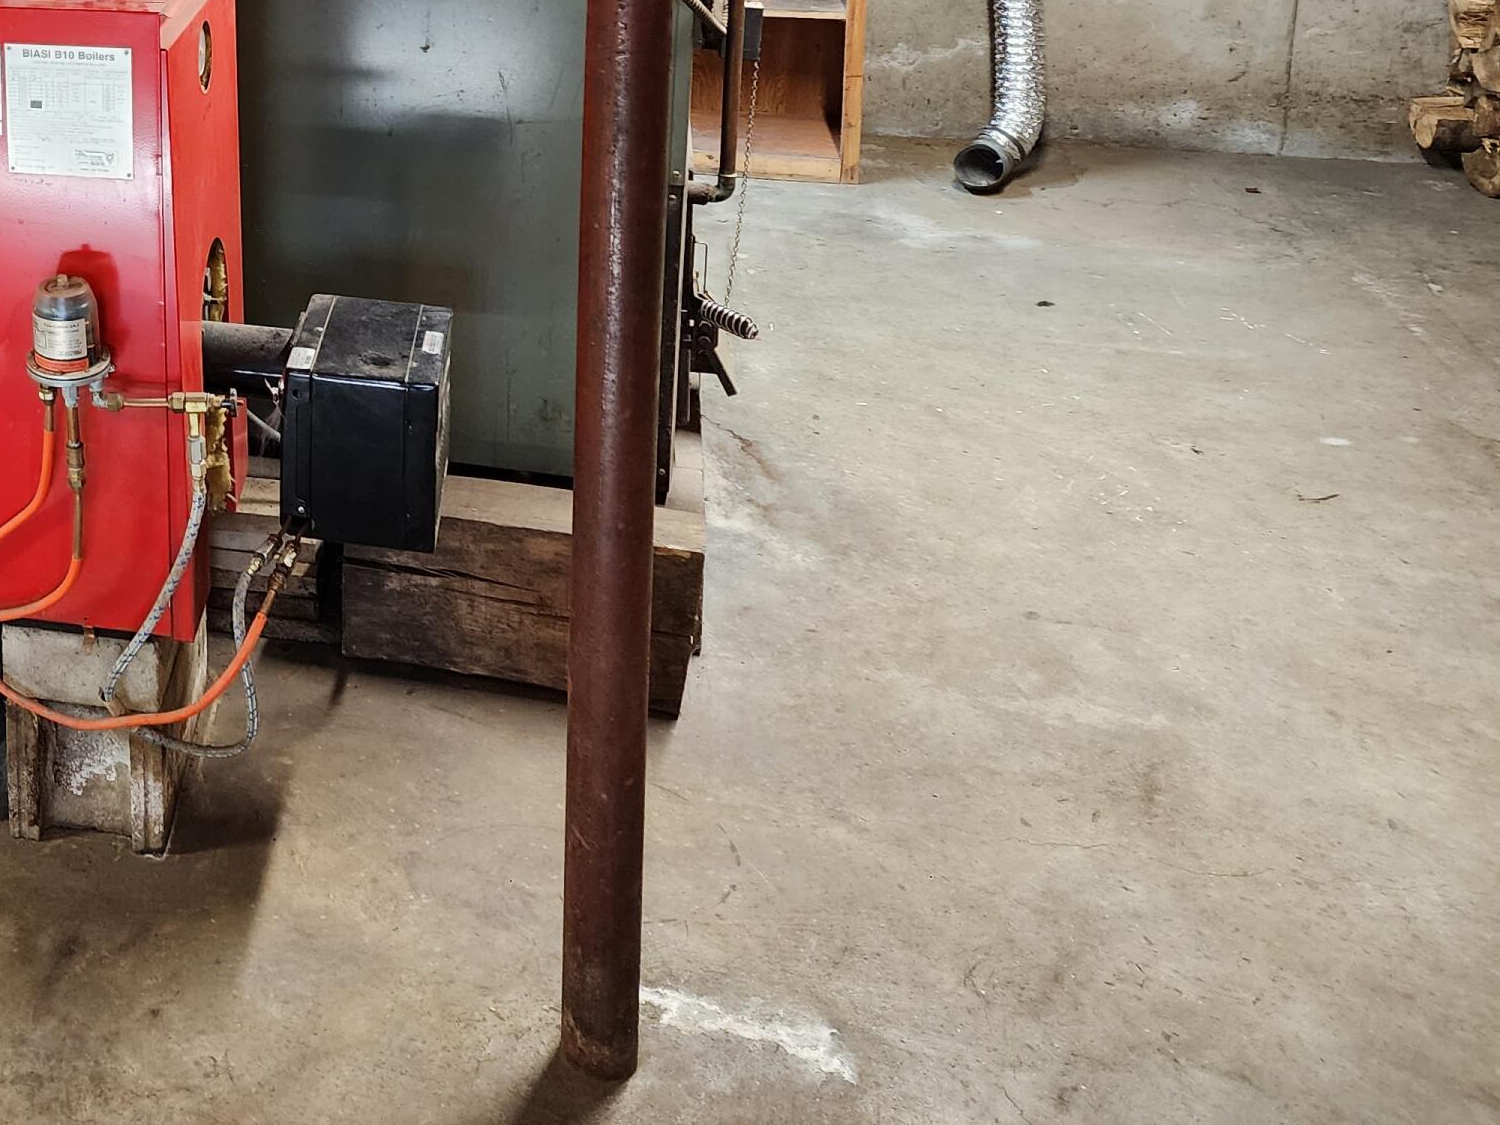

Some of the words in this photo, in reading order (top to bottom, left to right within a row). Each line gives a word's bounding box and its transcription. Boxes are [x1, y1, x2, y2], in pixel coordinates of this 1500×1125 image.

[22, 49, 51, 59] BIASI
[54, 50, 75, 60] B10
[78, 51, 116, 62] Boilers
